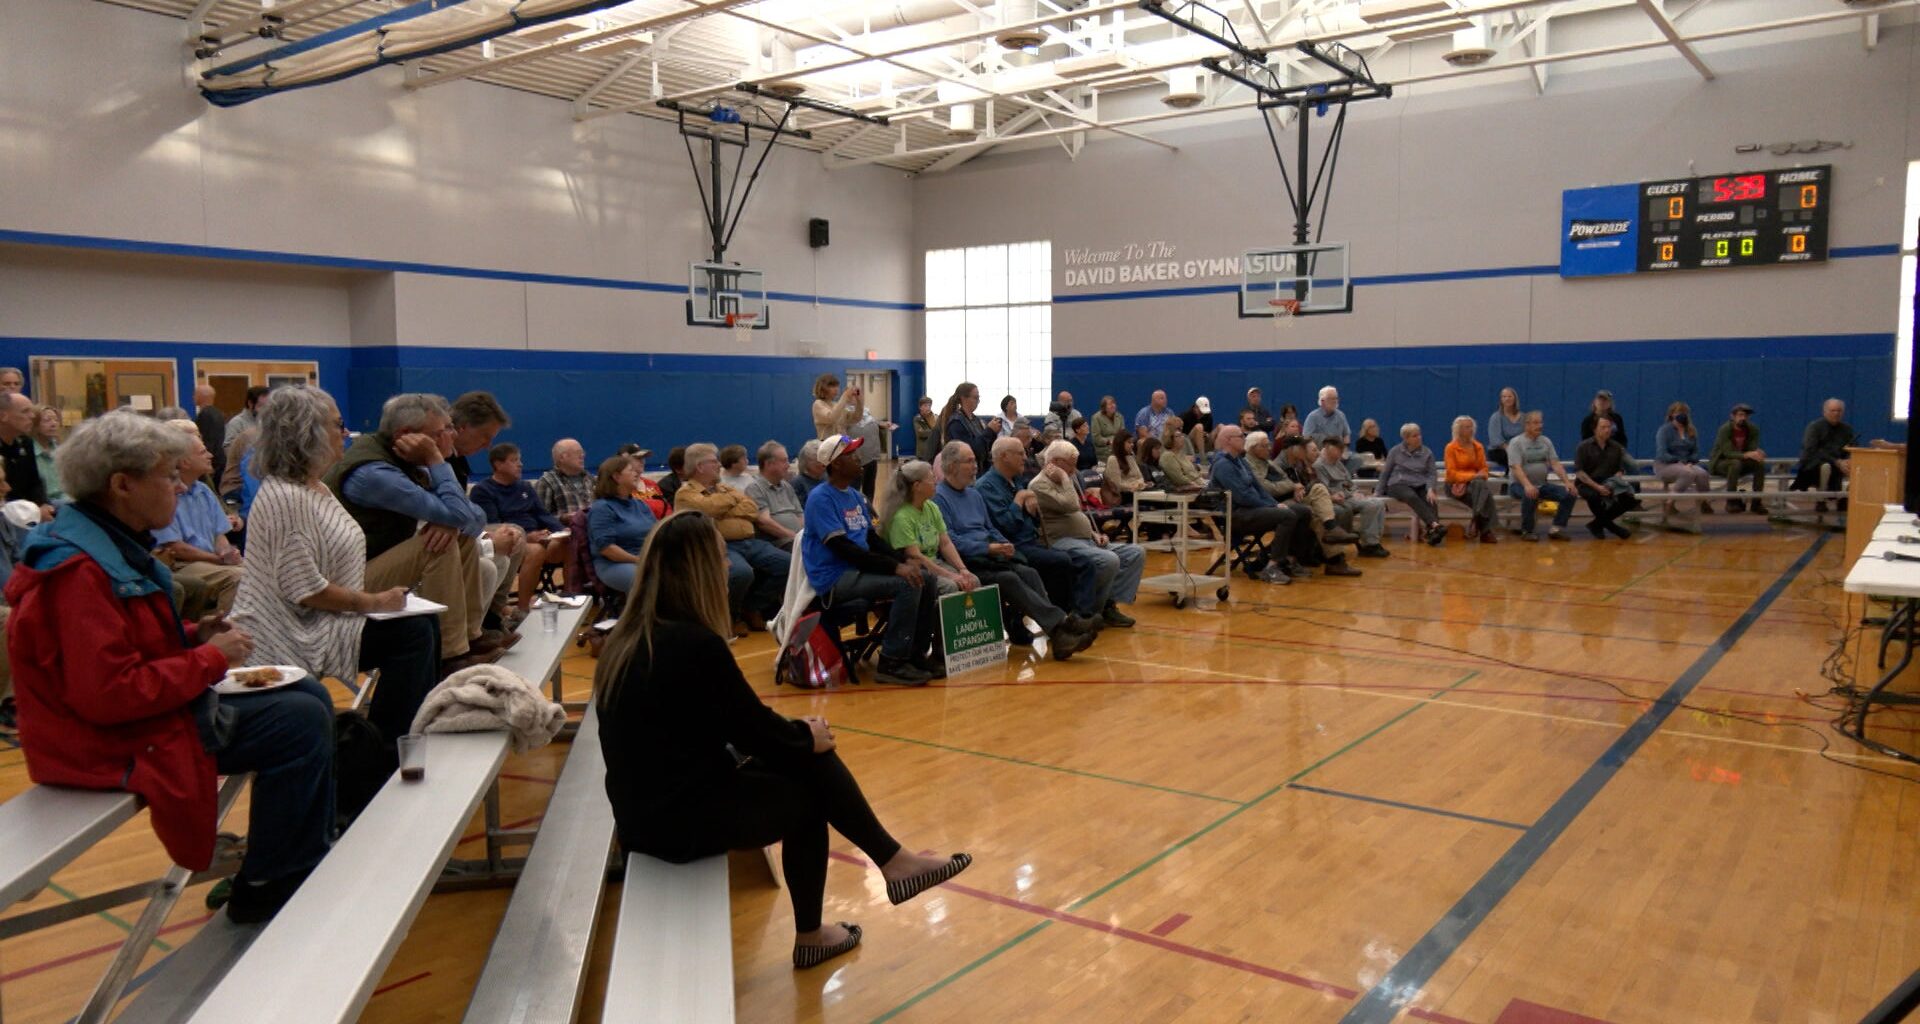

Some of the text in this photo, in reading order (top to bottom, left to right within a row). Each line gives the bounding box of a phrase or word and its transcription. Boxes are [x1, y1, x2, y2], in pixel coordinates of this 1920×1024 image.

[1779, 171, 1821, 183] HOME
[1647, 183, 1688, 196] GUEST
[1713, 175, 1765, 202] 5:39
[1801, 185, 1817, 209] 0
[1669, 197, 1684, 219] 0
[1696, 211, 1735, 222] PERIOD
[1569, 220, 1631, 236] POWERADE
[1662, 243, 1674, 261] 0
[1717, 239, 1753, 257] 0 0
[1792, 234, 1805, 252] 0
[1064, 241, 1176, 265] Welcome To The
[1064, 267, 1116, 286] DAVID
[1119, 261, 1180, 282] BAKER
[965, 608, 976, 619] NO
[956, 620, 989, 635] LANDFILL
